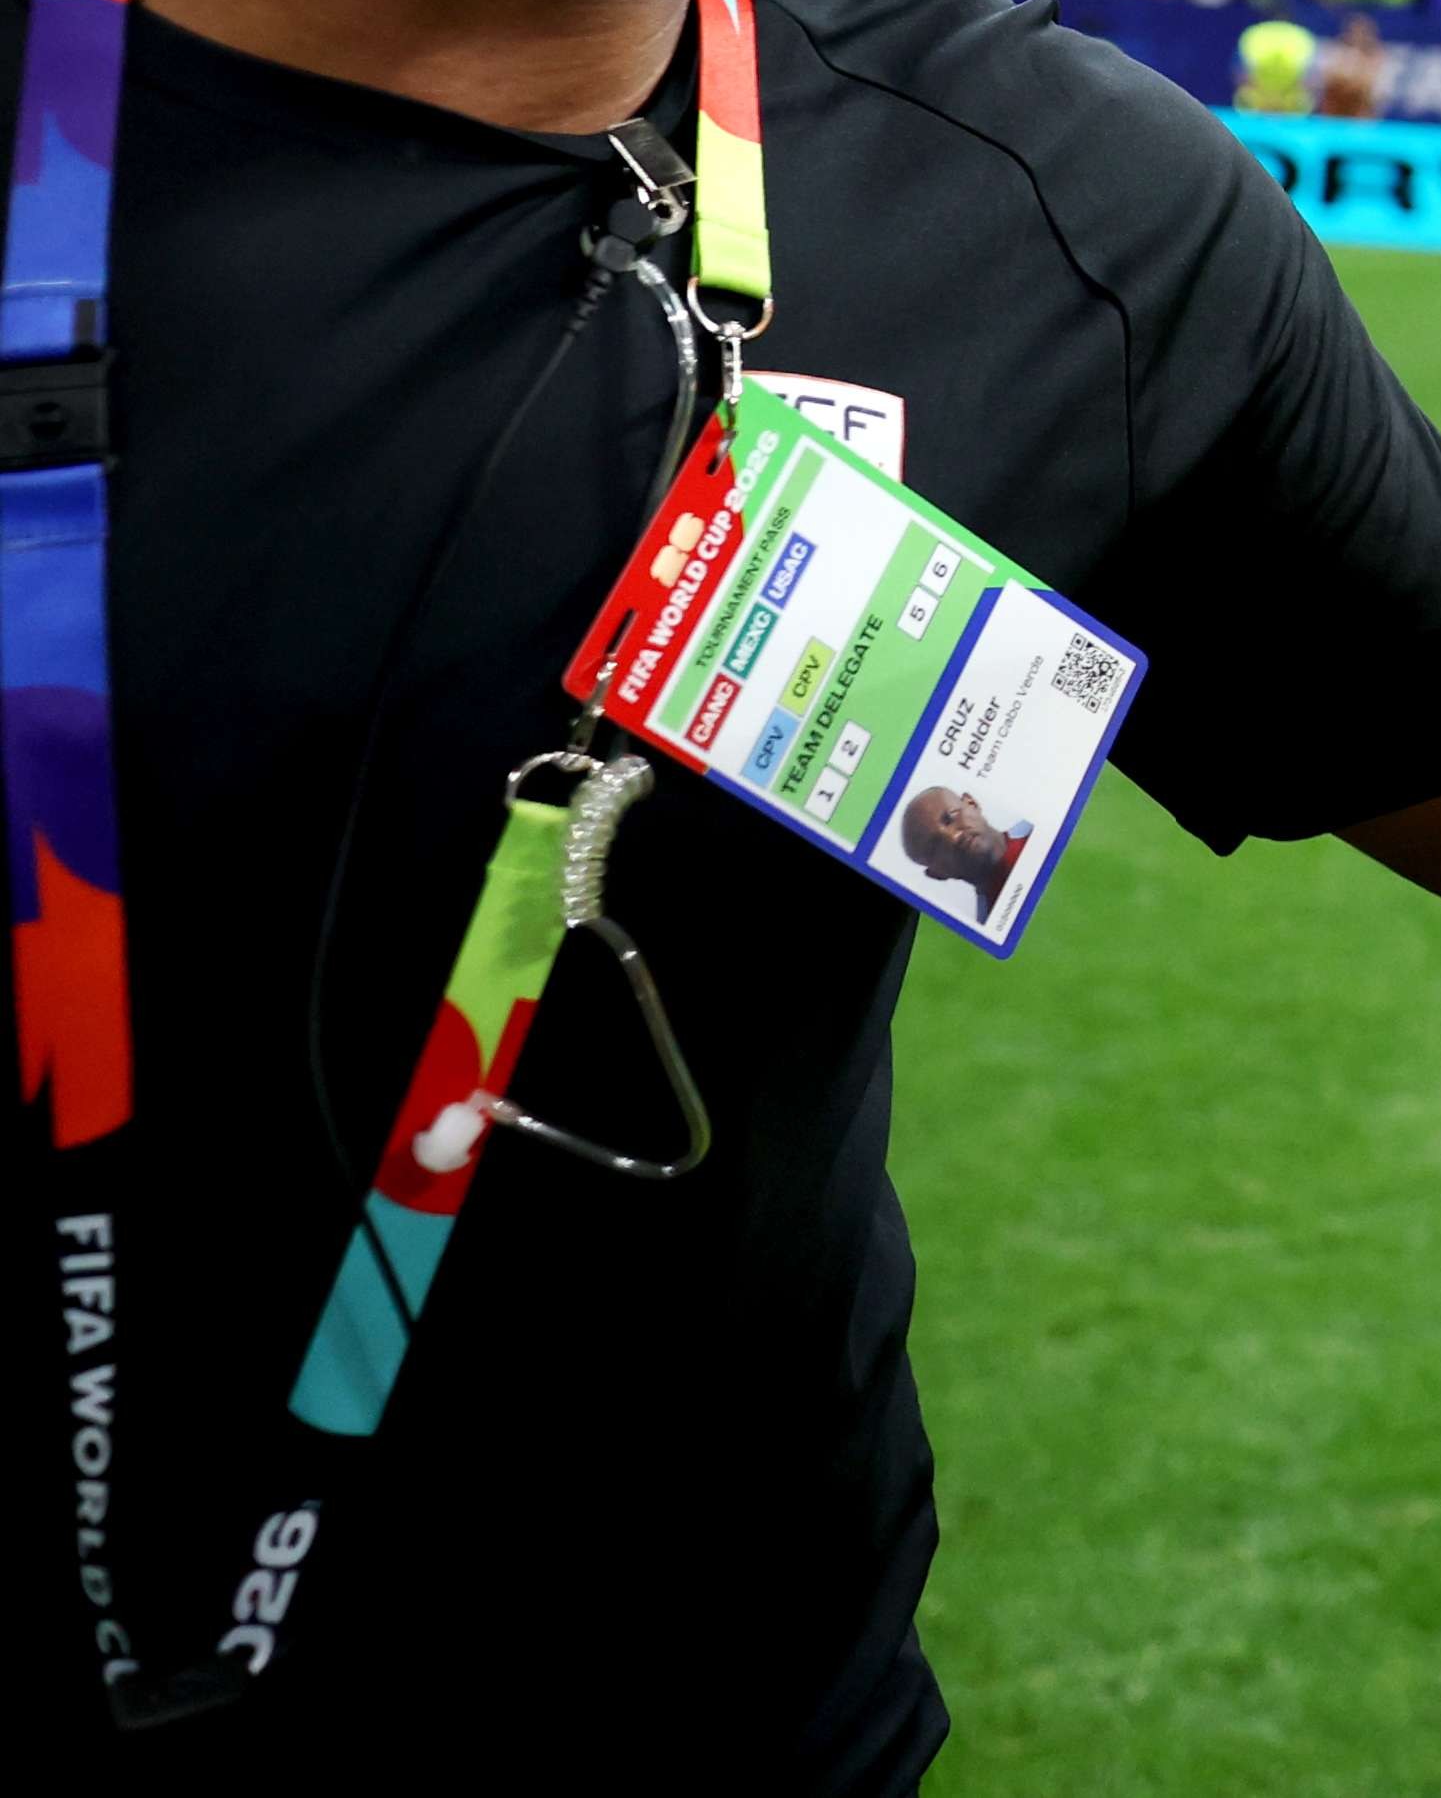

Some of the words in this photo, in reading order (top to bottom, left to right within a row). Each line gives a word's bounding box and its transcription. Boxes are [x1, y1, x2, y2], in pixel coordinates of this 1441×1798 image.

[617, 649, 663, 704] FIFA
[647, 559, 708, 647] WORLD
[696, 509, 732, 562] CUP
[724, 430, 781, 513] 2026
[696, 552, 763, 668] TOURNAMENT
[760, 506, 791, 553] PASS
[755, 726, 785, 770] CPV
[793, 655, 822, 699] CPV
[782, 730, 824, 795] TEAM
[816, 613, 884, 729] DELEGATE
[818, 788, 835, 802] 1
[841, 739, 860, 757] 2
[909, 604, 926, 622] 5
[932, 562, 949, 578] 6
[938, 698, 975, 757] CRUZ
[958, 696, 1001, 770] Helder
[976, 740, 1003, 779] Team
[998, 699, 1022, 739] Cabo
[56, 1213, 116, 1354] FIFA
[69, 1363, 118, 1607] WORLD
